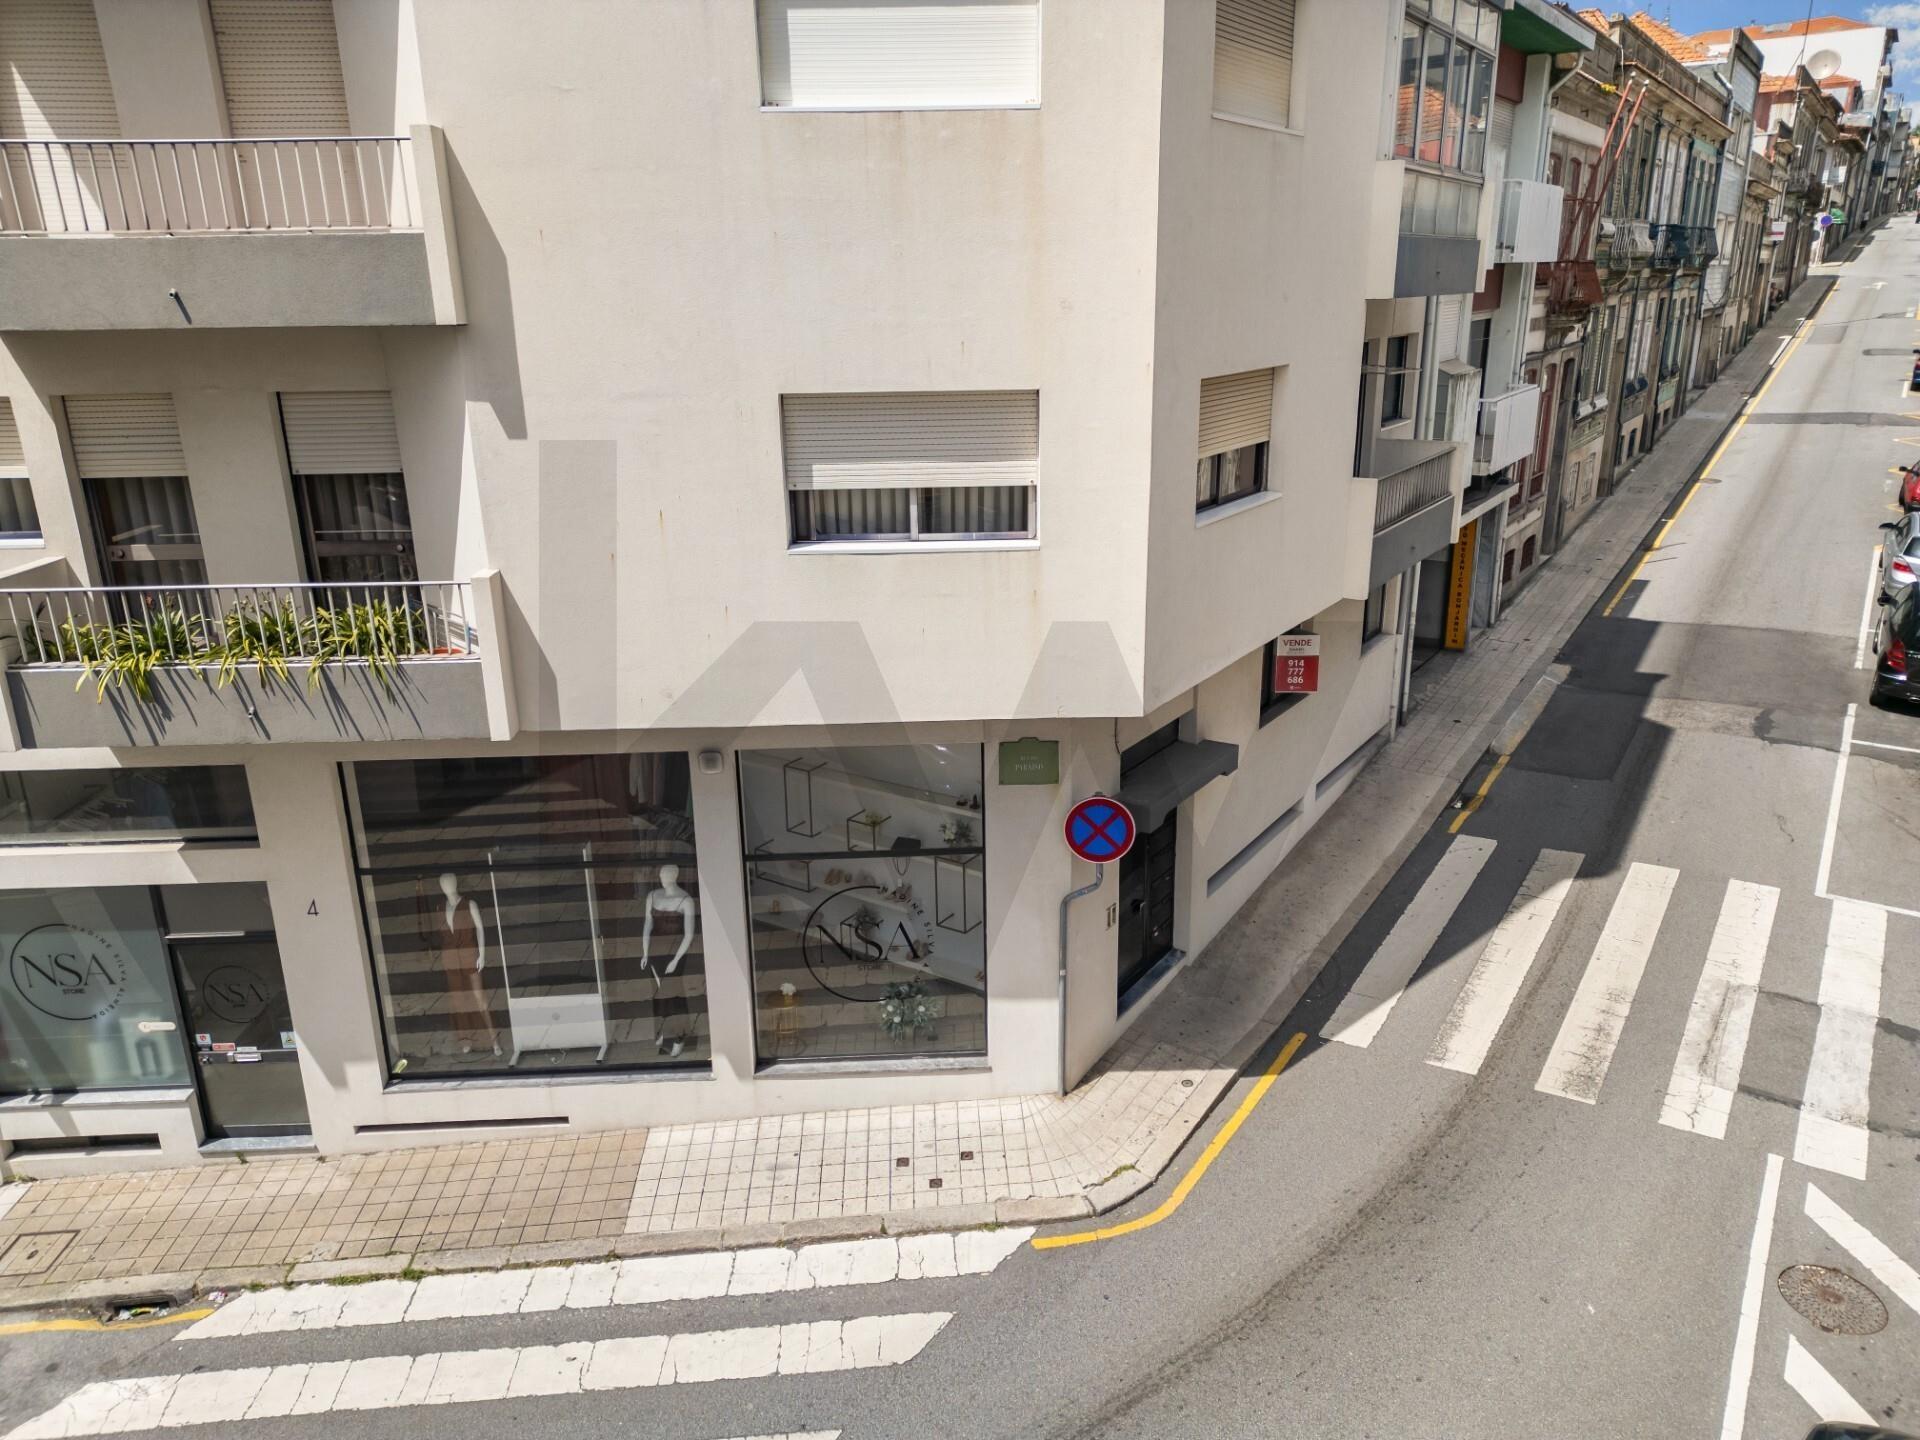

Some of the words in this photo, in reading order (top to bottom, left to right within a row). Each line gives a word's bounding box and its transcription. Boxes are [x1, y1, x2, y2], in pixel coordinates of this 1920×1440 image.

[1283, 639, 1313, 647] VENDE
[1288, 659, 1305, 667] 914
[1287, 676, 1304, 684] 686
[307, 900, 320, 917] 4
[816, 921, 921, 963] NSA
[923, 921, 936, 956] SILVA
[17, 952, 117, 989] NSA
[208, 983, 265, 1003] NSA
